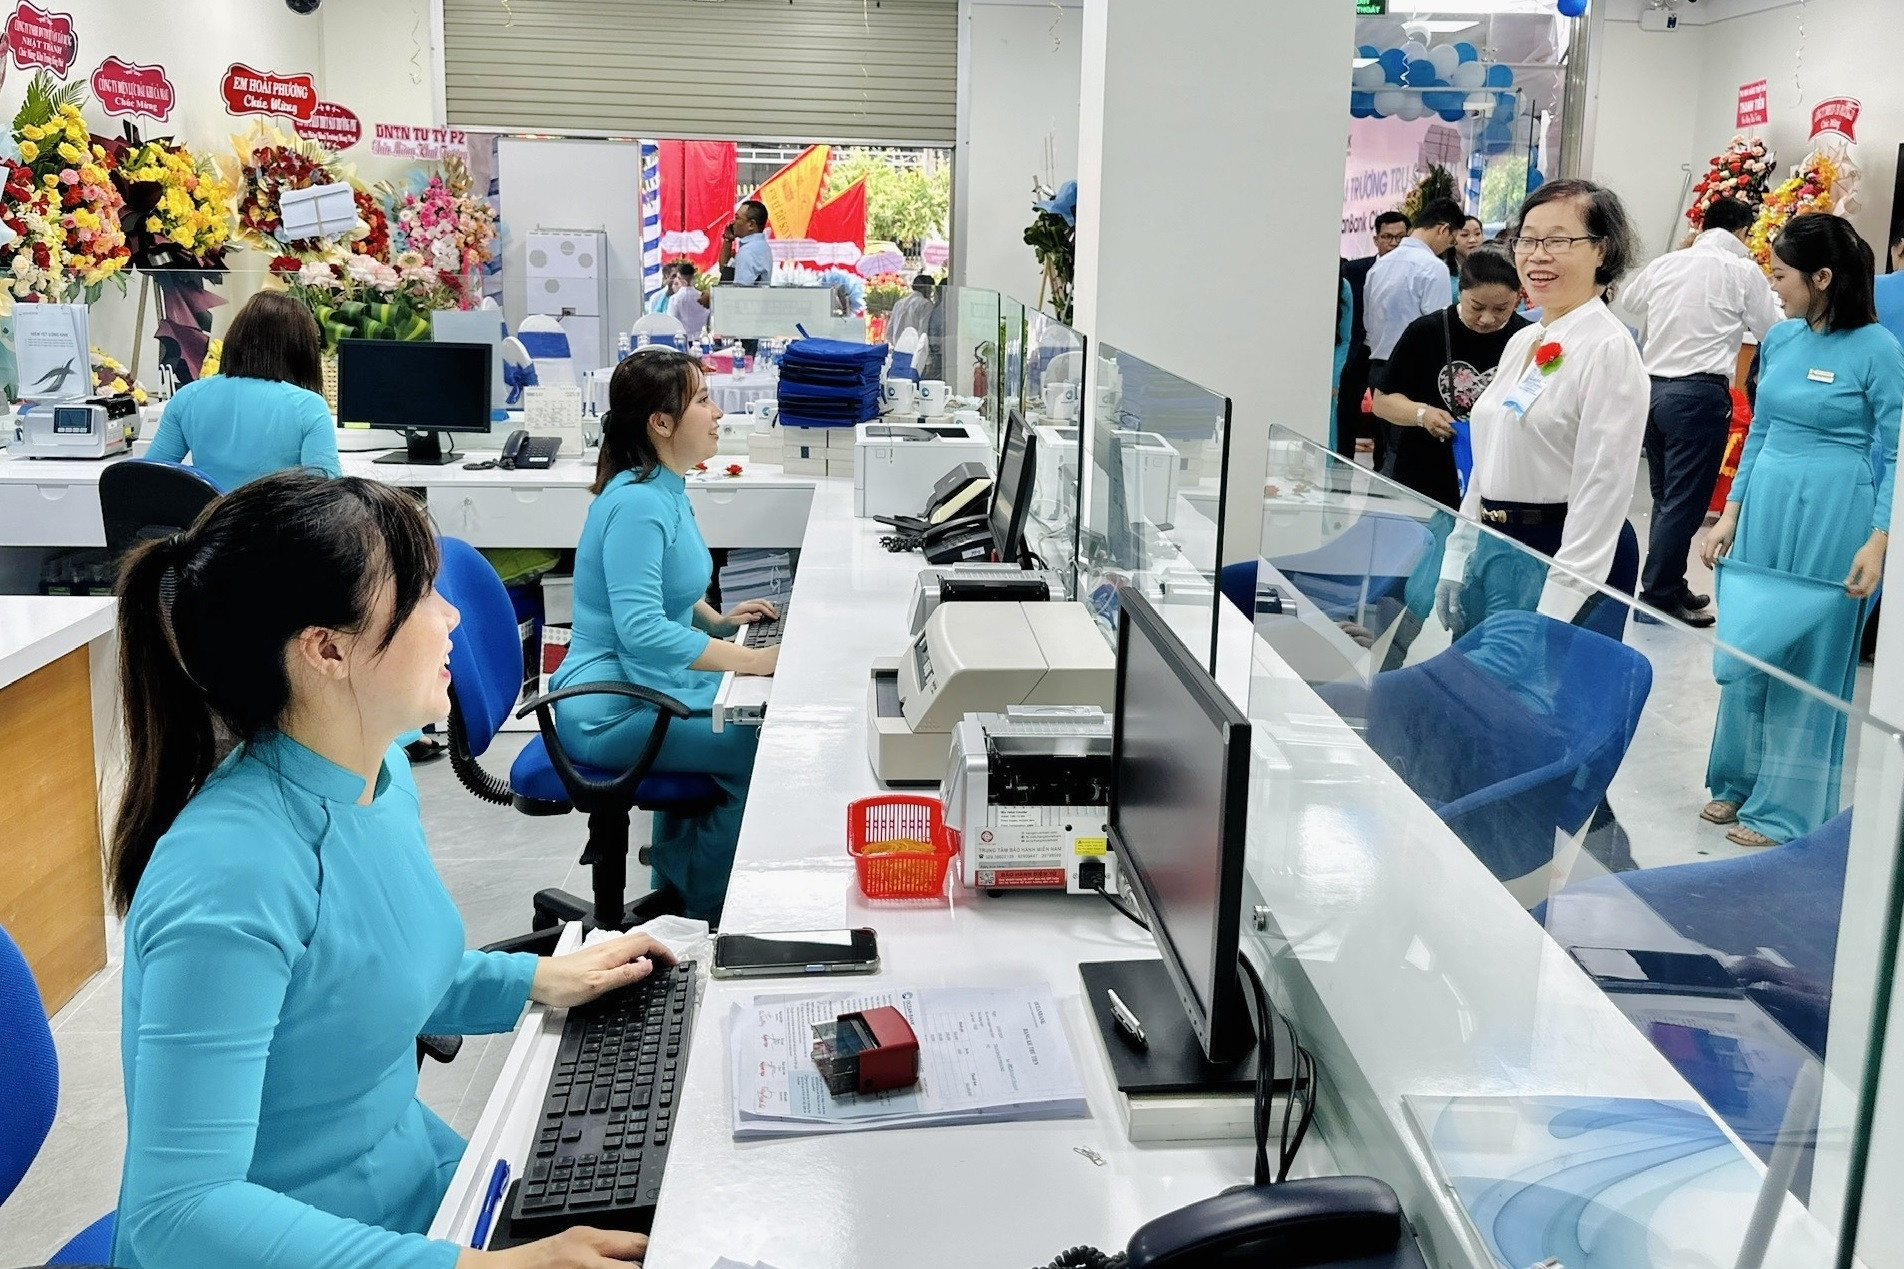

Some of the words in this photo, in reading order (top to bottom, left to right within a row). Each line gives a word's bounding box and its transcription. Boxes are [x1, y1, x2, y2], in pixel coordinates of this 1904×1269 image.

[22, 36, 42, 49] NHẬT
[99, 75, 111, 92] CÔNG
[112, 79, 118, 94] TY
[233, 77, 248, 91] EM
[249, 76, 272, 94] HOÀI
[273, 81, 308, 99] PHƯƠNG
[115, 97, 135, 107] Chúc
[136, 100, 158, 112] Mừng
[244, 94, 268, 109] Chúc
[271, 98, 298, 115] Mừng
[375, 124, 410, 140] DNTN
[450, 131, 465, 144] P2
